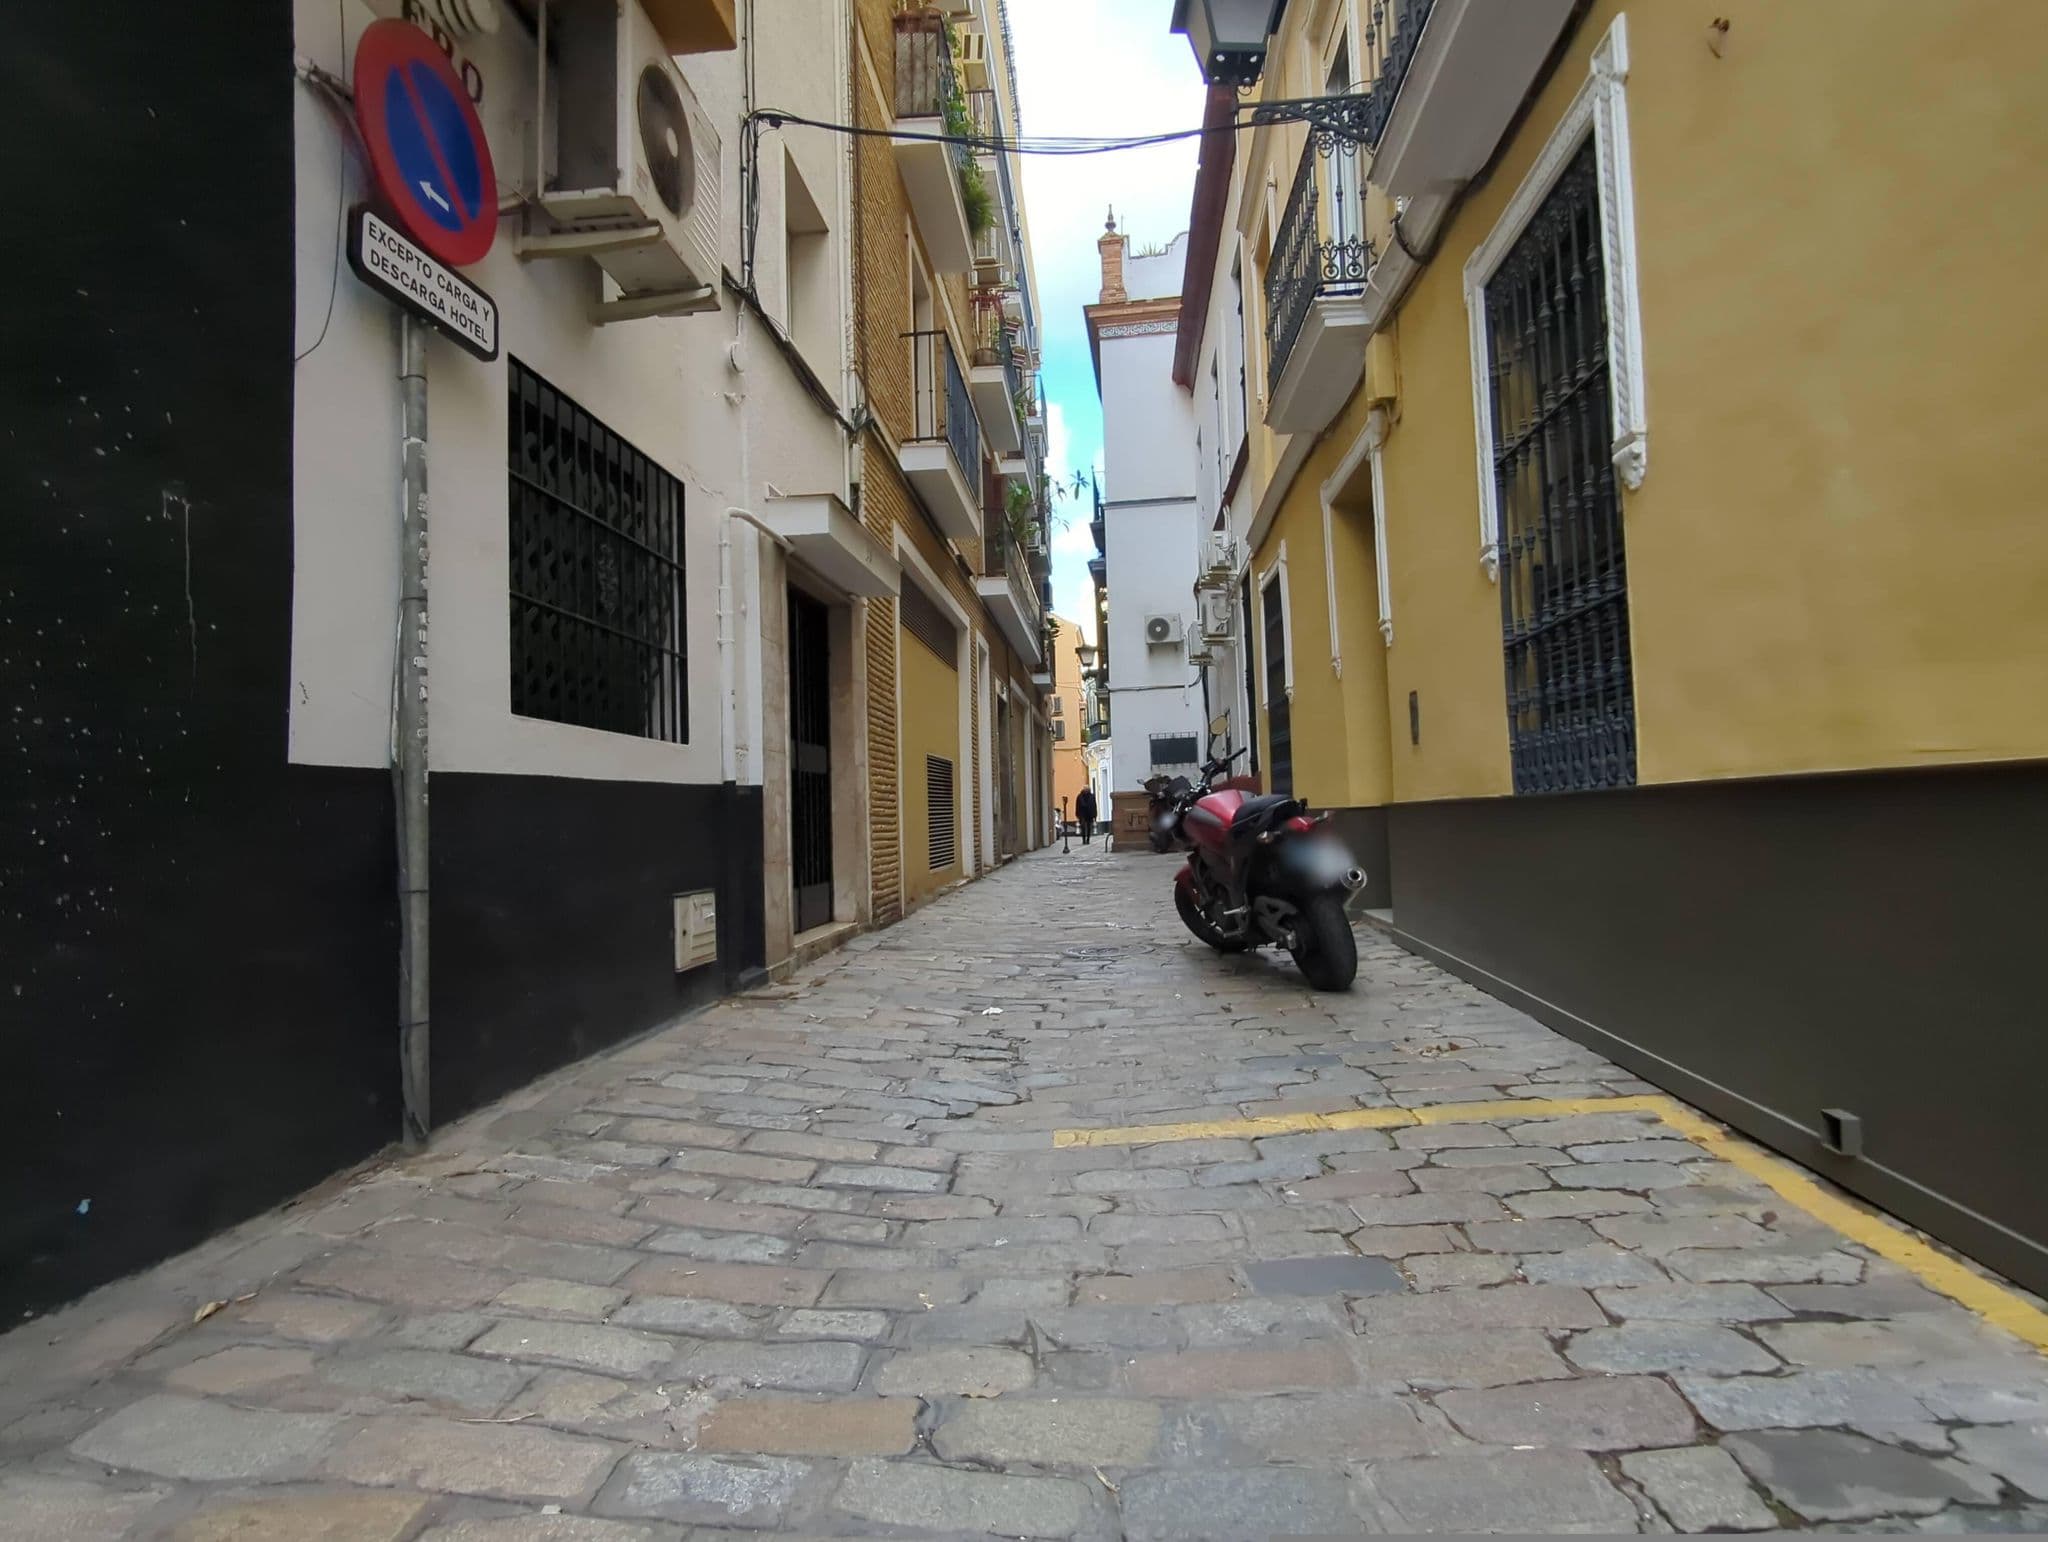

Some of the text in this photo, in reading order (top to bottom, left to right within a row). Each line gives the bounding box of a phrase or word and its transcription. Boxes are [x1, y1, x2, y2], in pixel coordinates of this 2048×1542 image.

[368, 220, 490, 322] EXCEPTO CARGA Y
[370, 249, 488, 344] DESCARGA HOTEL
